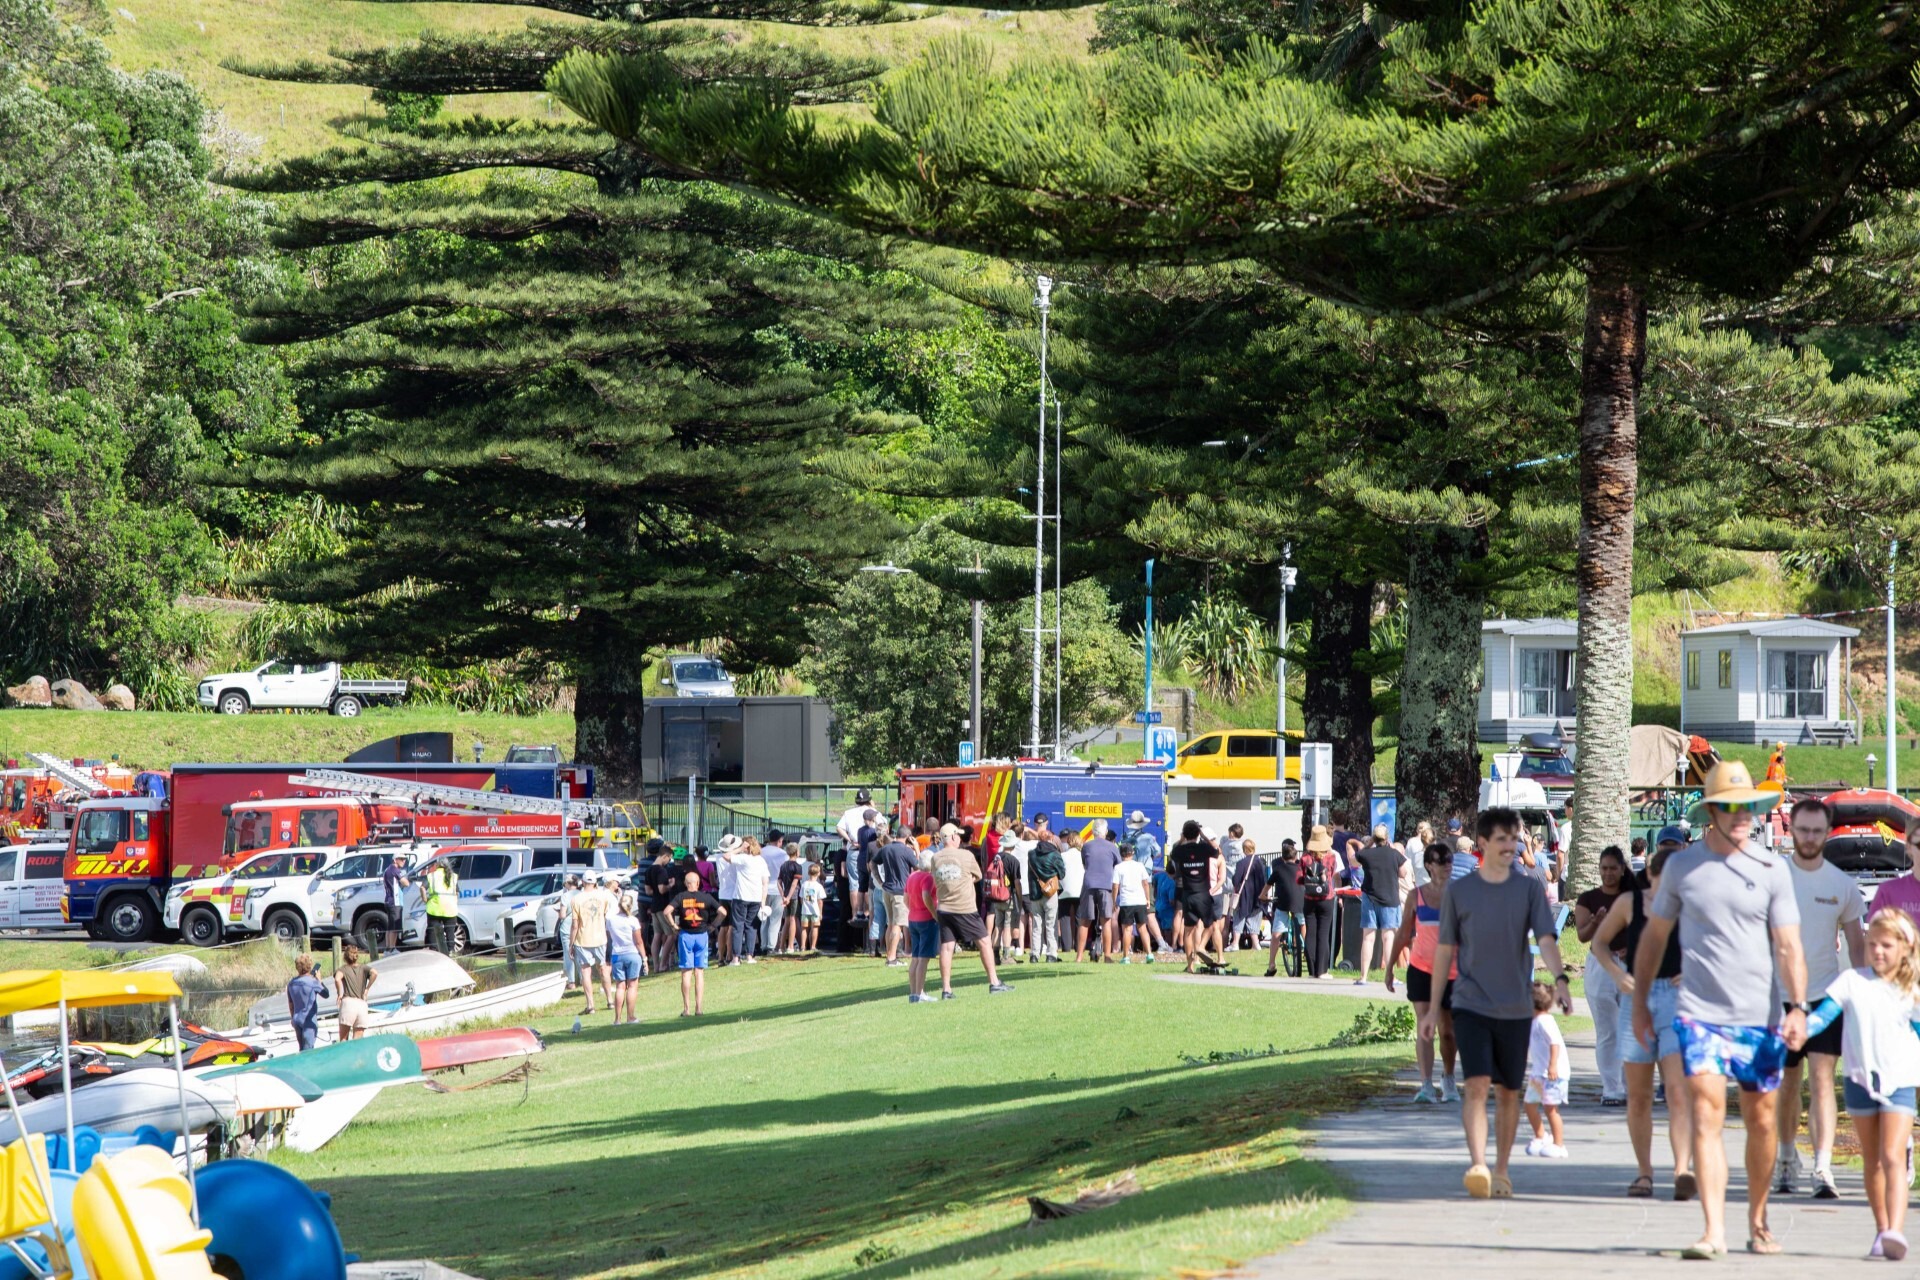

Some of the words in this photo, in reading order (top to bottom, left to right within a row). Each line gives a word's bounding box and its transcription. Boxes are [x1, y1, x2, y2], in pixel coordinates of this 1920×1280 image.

[1069, 805, 1086, 814] FIRE
[1088, 805, 1118, 815] RESCUE
[419, 826, 437, 834] CALL
[506, 825, 559, 833] EMERGENCY.NZ
[27, 856, 59, 866] ROOF
